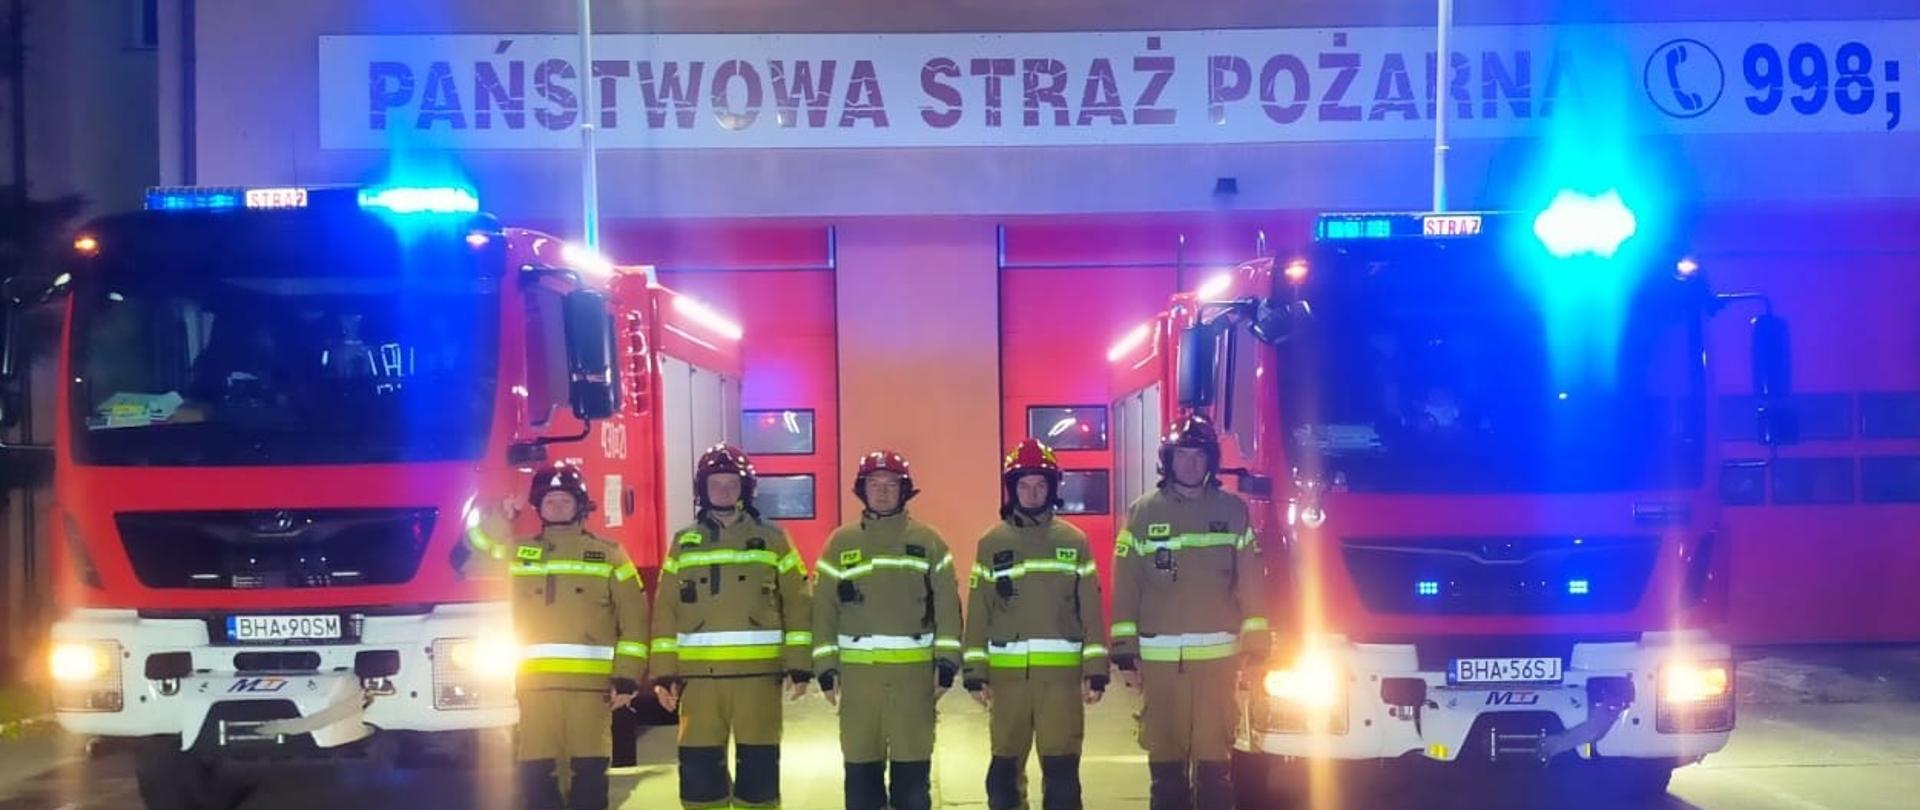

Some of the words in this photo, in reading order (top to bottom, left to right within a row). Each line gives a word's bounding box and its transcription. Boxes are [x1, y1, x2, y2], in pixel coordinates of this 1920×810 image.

[368, 40, 889, 130] PAŃSTWOWA
[920, 36, 1177, 128] STRAŻ
[240, 619, 281, 637] BHA
[1460, 661, 1502, 680] BHA
[1510, 660, 1556, 679] 56SJ
